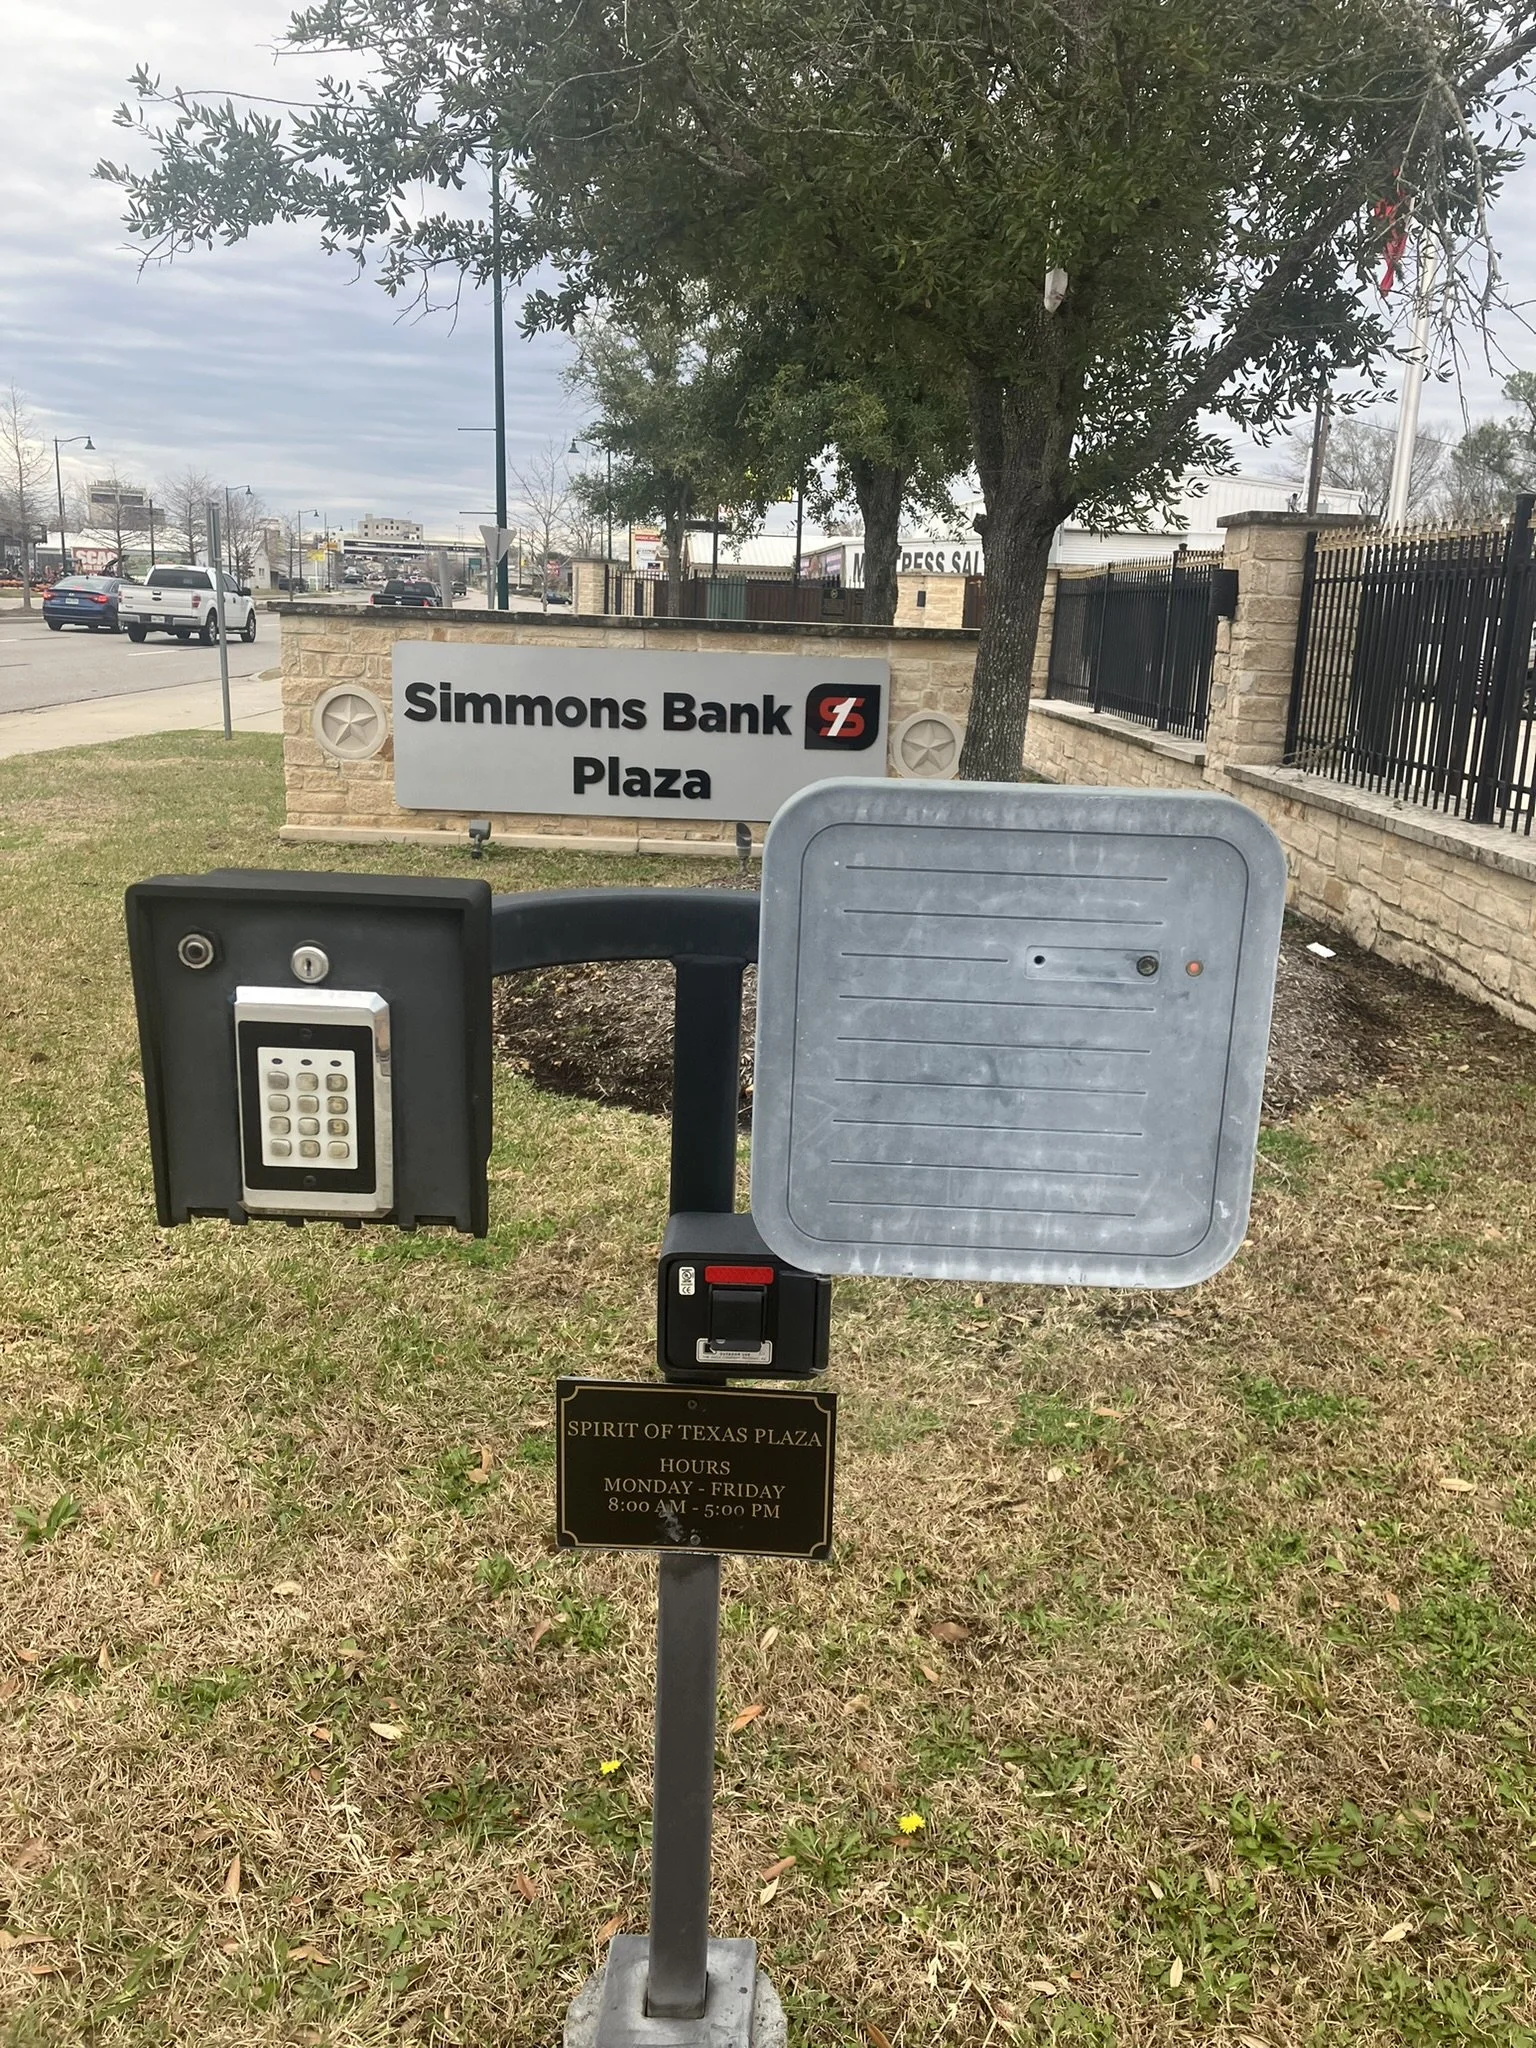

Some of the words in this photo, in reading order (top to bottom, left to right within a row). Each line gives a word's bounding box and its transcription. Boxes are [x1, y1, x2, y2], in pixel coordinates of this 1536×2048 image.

[853, 551, 945, 583] MRESS
[403, 681, 648, 731] Simmons
[663, 692, 793, 736] Bank
[573, 756, 712, 800] Plaza
[568, 1420, 638, 1438] SPIRIT
[645, 1423, 673, 1440] OF
[678, 1425, 748, 1443] TEXAS
[755, 1428, 823, 1447] PLAZA
[660, 1458, 731, 1476] HOURS
[604, 1478, 693, 1495] MONDAY
[711, 1482, 786, 1499] FRIDAY
[608, 1497, 649, 1513] 8:00
[654, 1499, 686, 1514] AM
[704, 1503, 745, 1519] 5:00
[752, 1503, 780, 1519] PM
